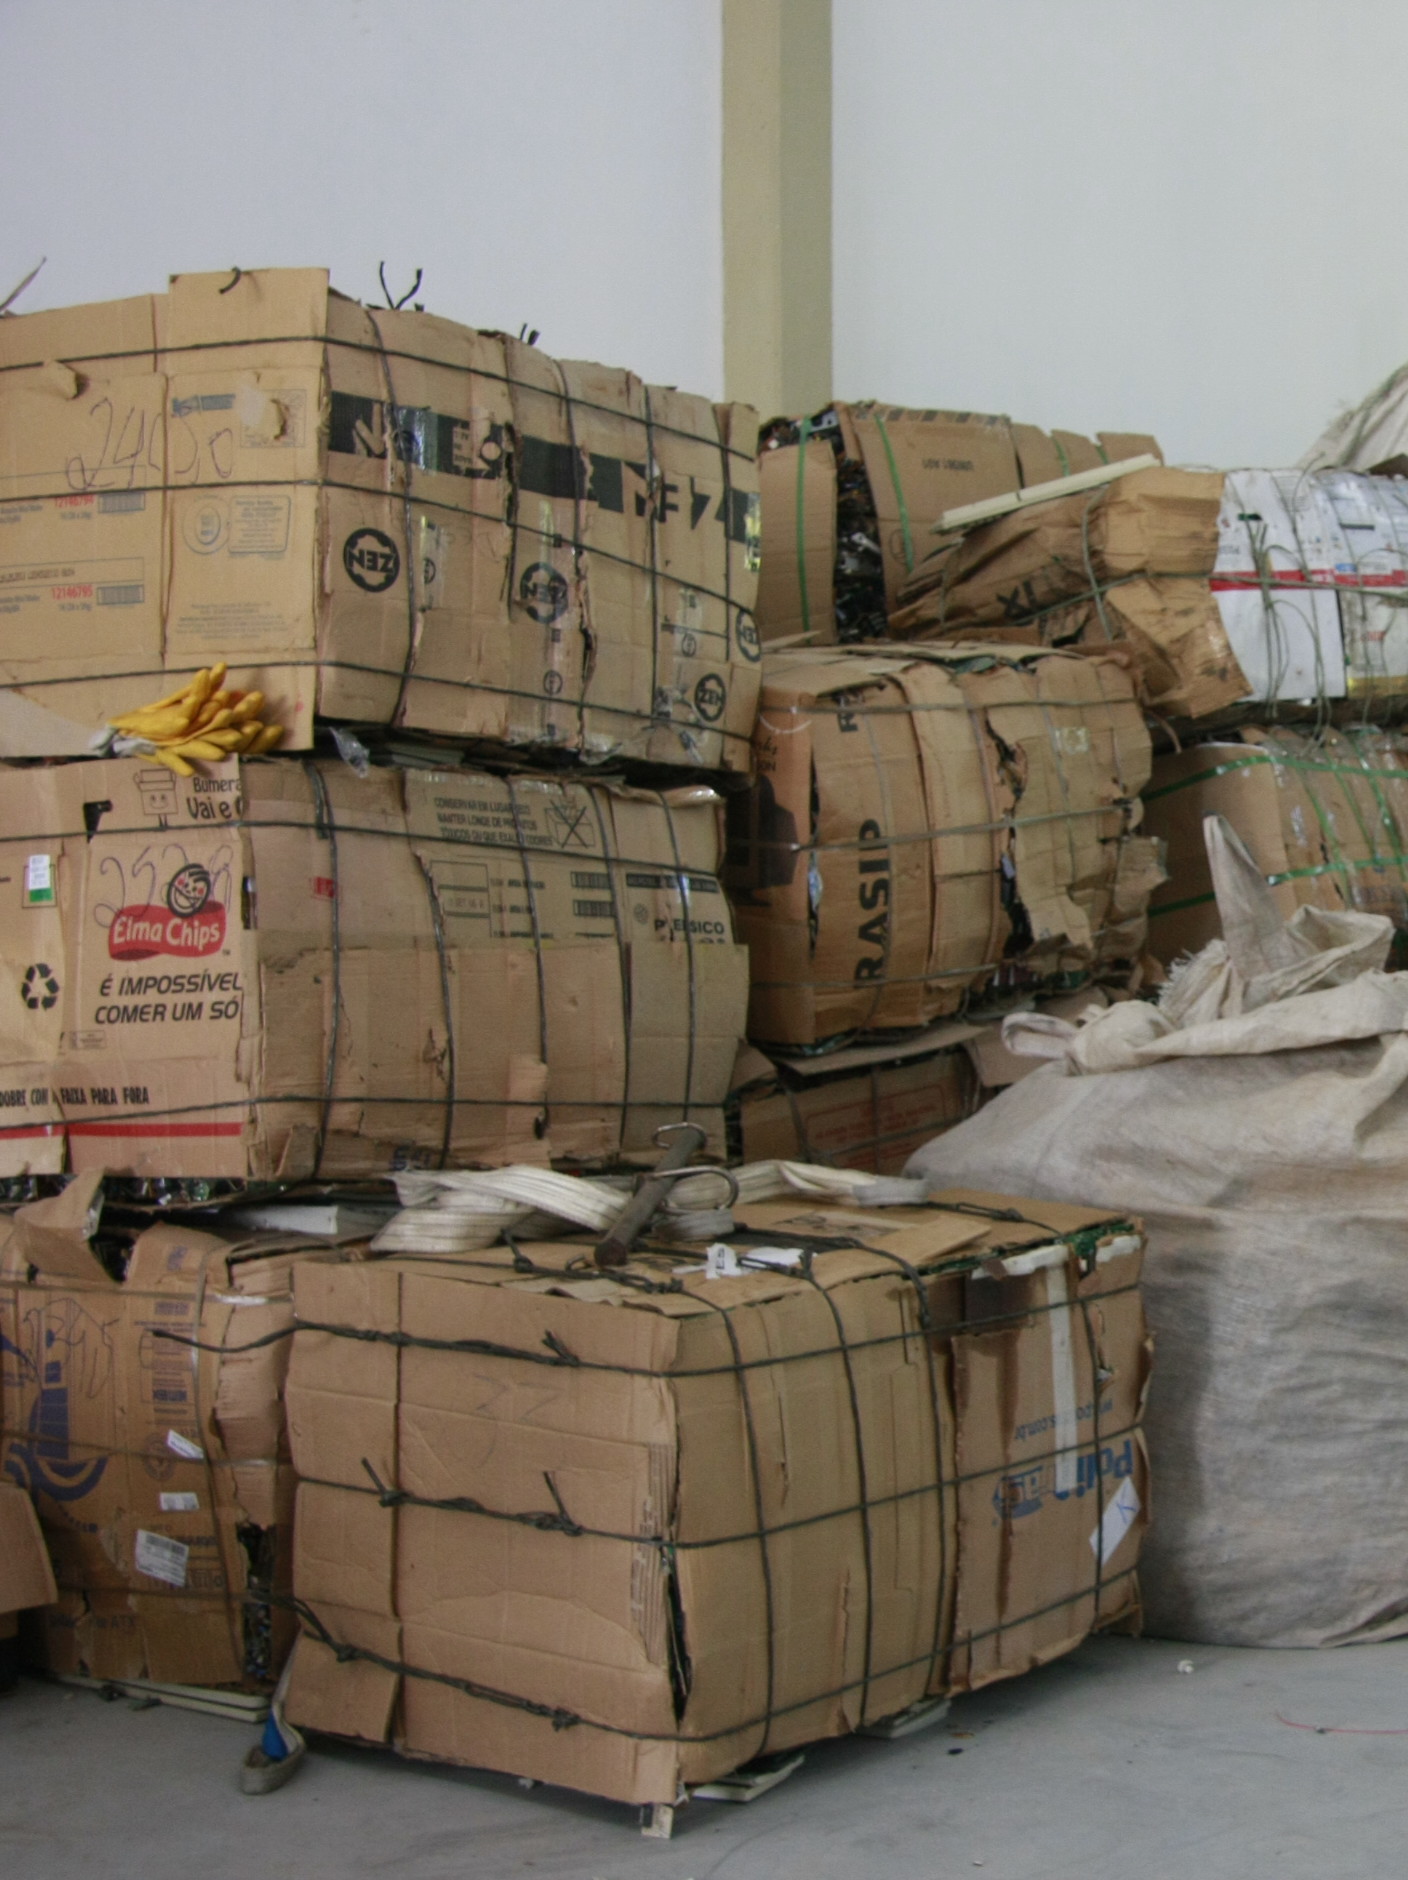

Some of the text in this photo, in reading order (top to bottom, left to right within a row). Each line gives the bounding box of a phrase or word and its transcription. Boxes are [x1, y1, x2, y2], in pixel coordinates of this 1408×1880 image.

[350, 547, 396, 575] ZEN
[187, 797, 232, 820] Vai e
[853, 818, 890, 989] RASIP
[113, 915, 163, 945] Elma
[166, 916, 221, 952] Chips
[100, 969, 242, 996] É IMPOSSÍVEL
[95, 999, 240, 1024] COMER UM SÓ
[91, 1086, 118, 1105] PARA
[123, 1086, 149, 1104] FORA
